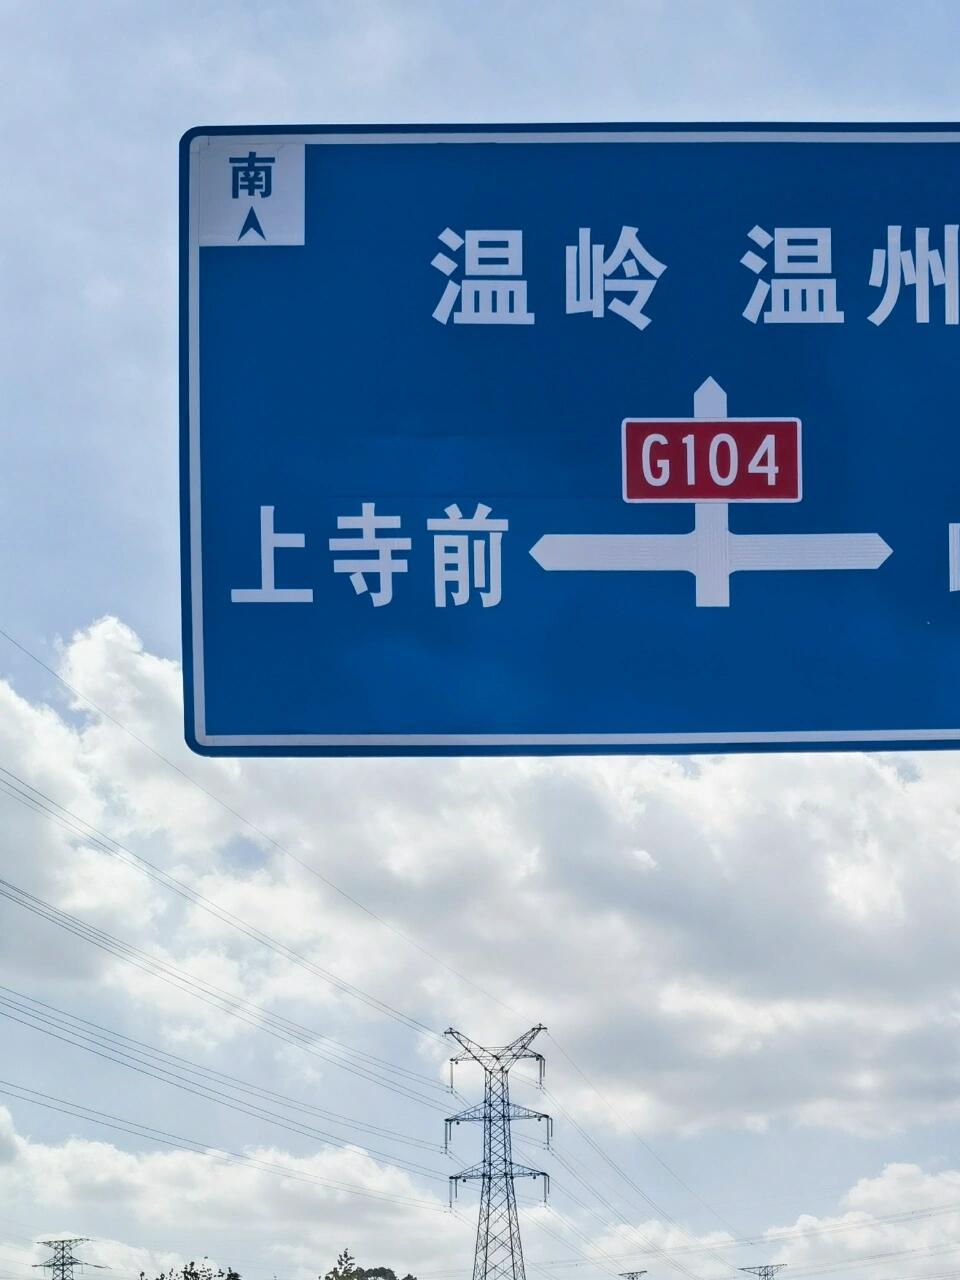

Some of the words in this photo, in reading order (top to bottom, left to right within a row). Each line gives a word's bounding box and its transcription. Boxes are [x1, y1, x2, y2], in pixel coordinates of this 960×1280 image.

[228, 151, 277, 200] 南
[430, 224, 669, 332] 温岭
[640, 433, 780, 488] G104
[230, 501, 510, 609] 上寺前
